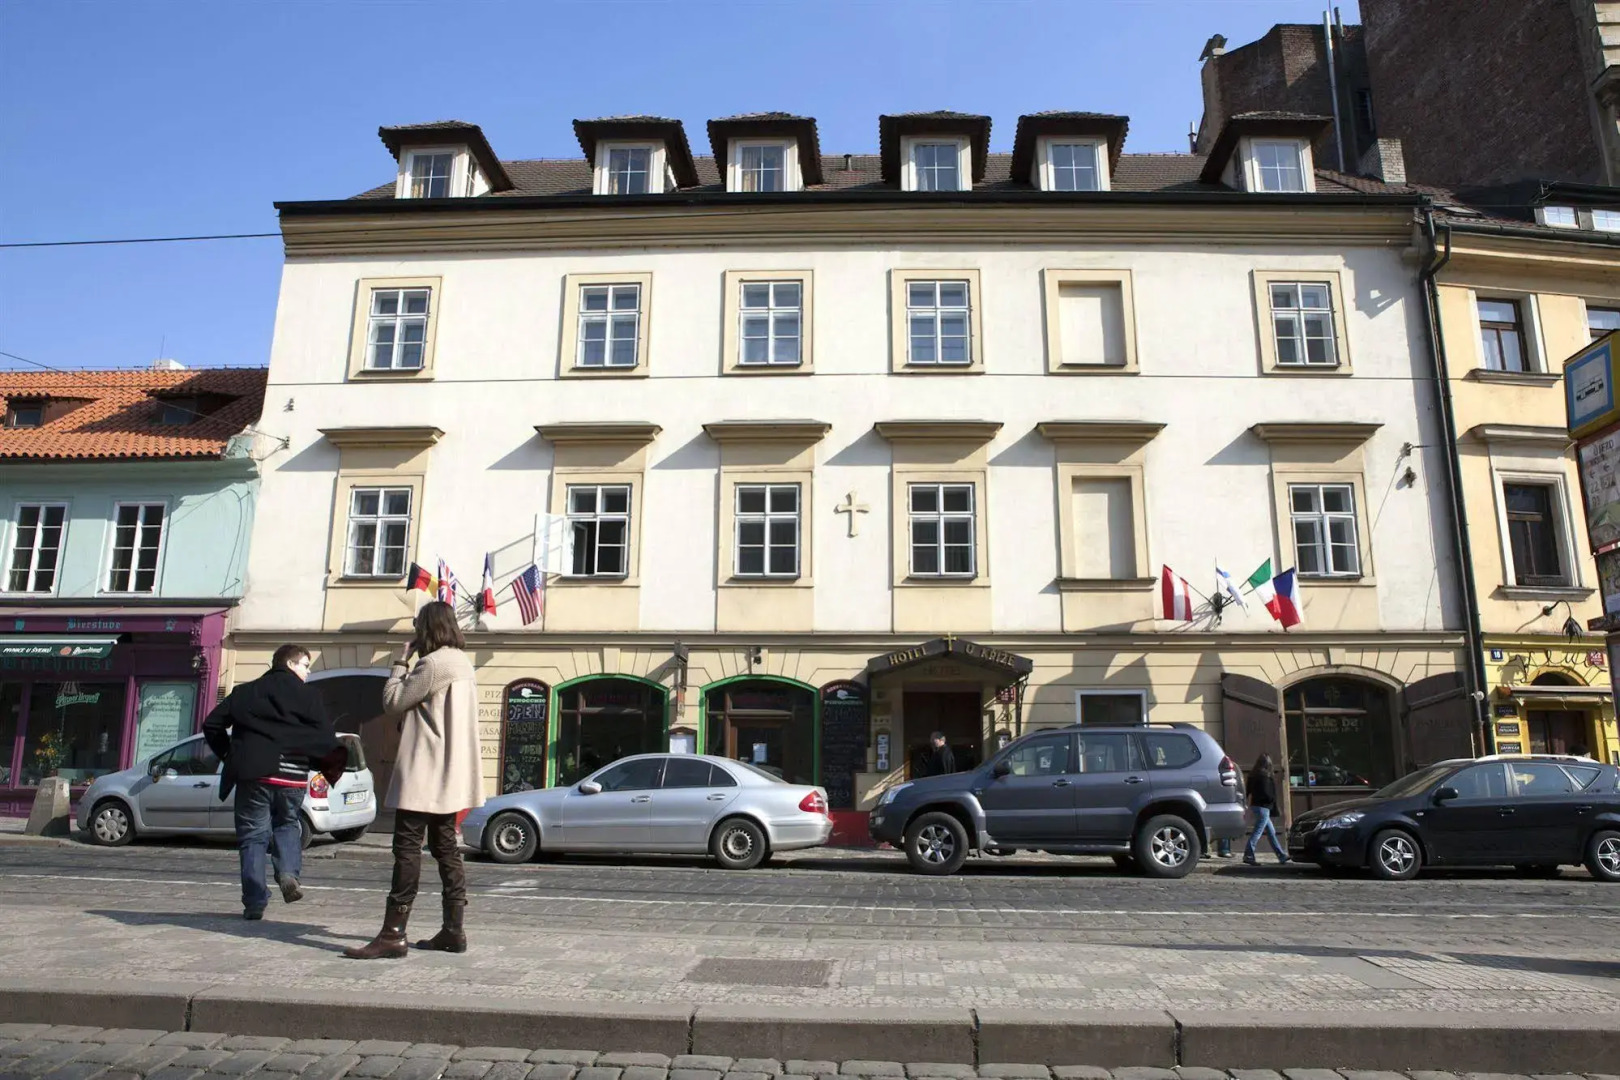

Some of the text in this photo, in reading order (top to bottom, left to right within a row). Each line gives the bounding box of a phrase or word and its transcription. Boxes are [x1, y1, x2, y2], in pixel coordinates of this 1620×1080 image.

[965, 644, 974, 653] U
[484, 690, 502, 698] PIZ
[478, 709, 503, 717] PAGH
[479, 728, 502, 736] ASA
[481, 746, 499, 754] PAS
